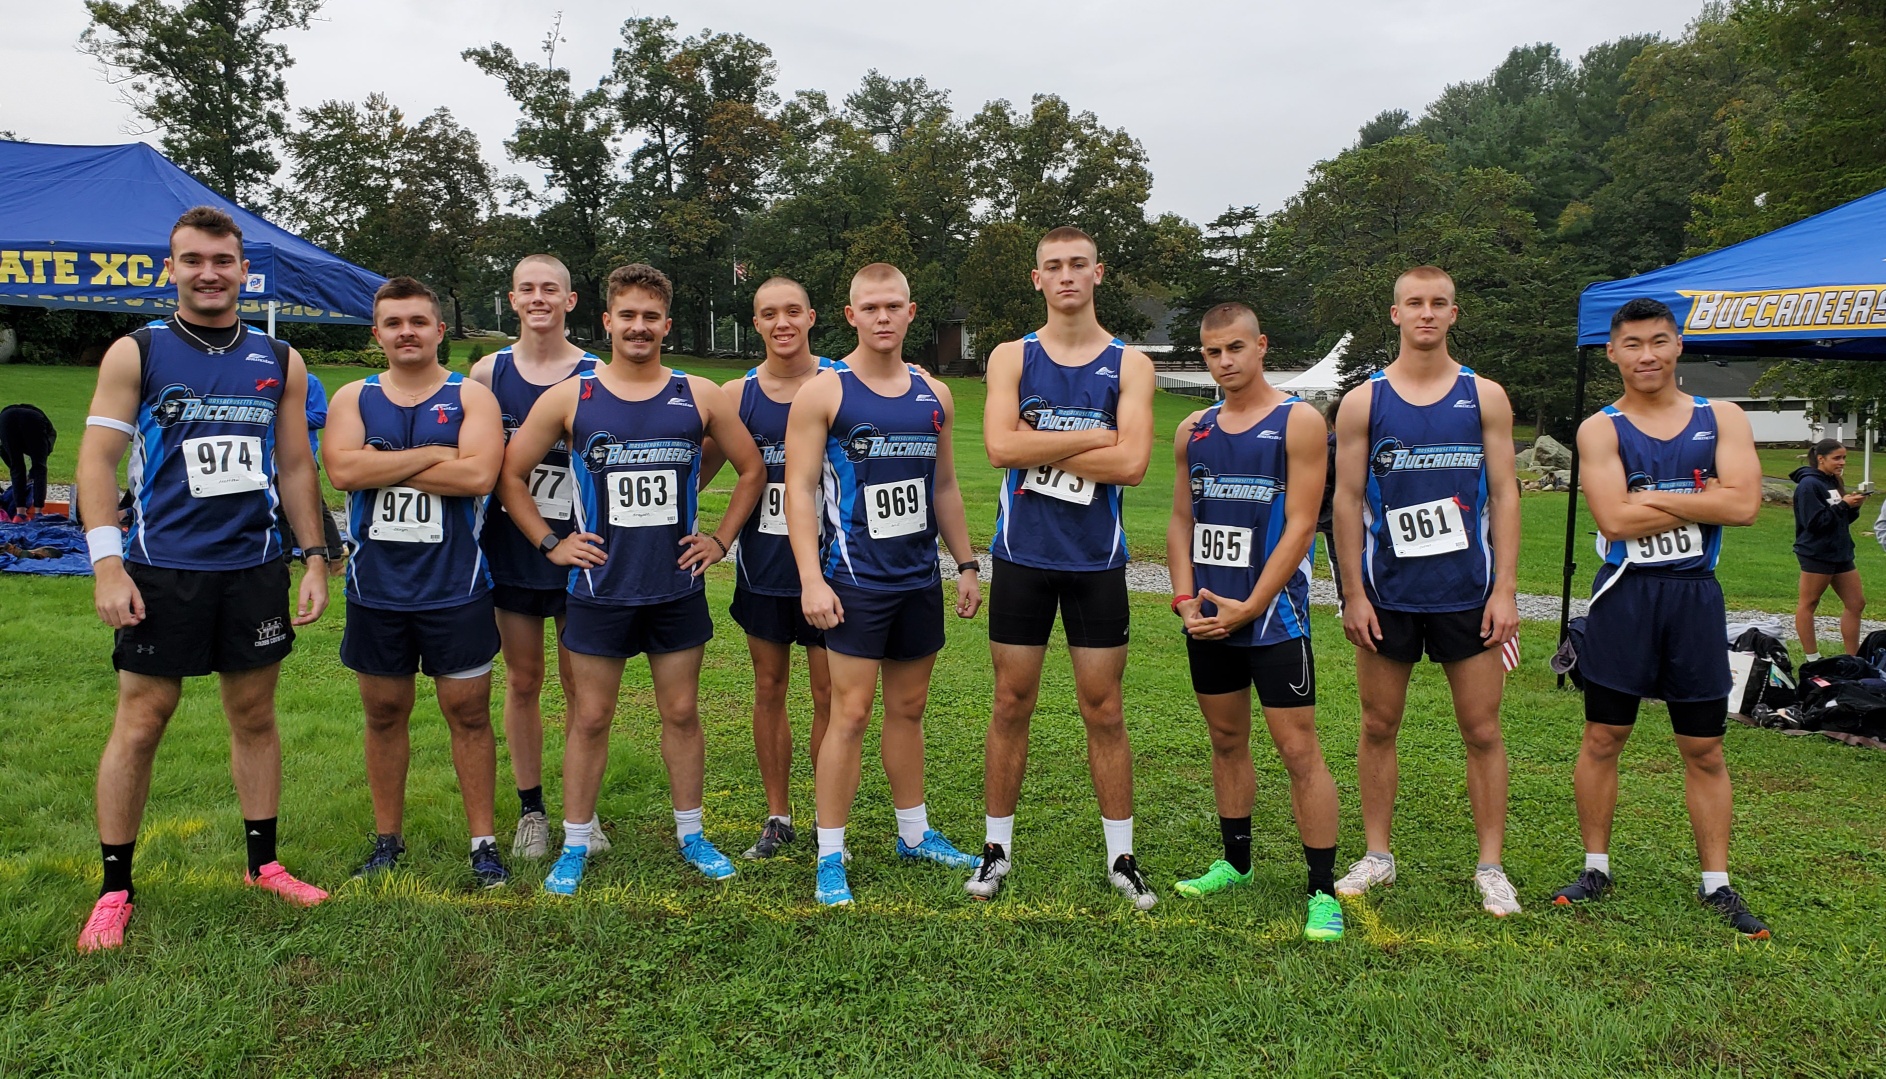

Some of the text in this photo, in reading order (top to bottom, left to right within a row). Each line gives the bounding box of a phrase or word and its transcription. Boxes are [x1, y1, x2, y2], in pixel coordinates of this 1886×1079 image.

[0, 250, 79, 284] ATE
[1688, 288, 1886, 330] BUCCANEERS
[1034, 409, 1109, 431] BUCCANERS
[197, 440, 252, 475] 974
[603, 444, 694, 465] BUCCANEERS
[867, 436, 937, 457] BUCCANEER
[1390, 449, 1484, 470] BUCCANEERS
[531, 468, 566, 500] 77
[619, 475, 668, 508] 963
[1202, 477, 1277, 502] BUCCANERS
[382, 491, 431, 523] 970
[875, 484, 919, 519] 969
[1399, 505, 1451, 542] 961
[1202, 529, 1242, 561] 965
[1638, 526, 1691, 558] 966
